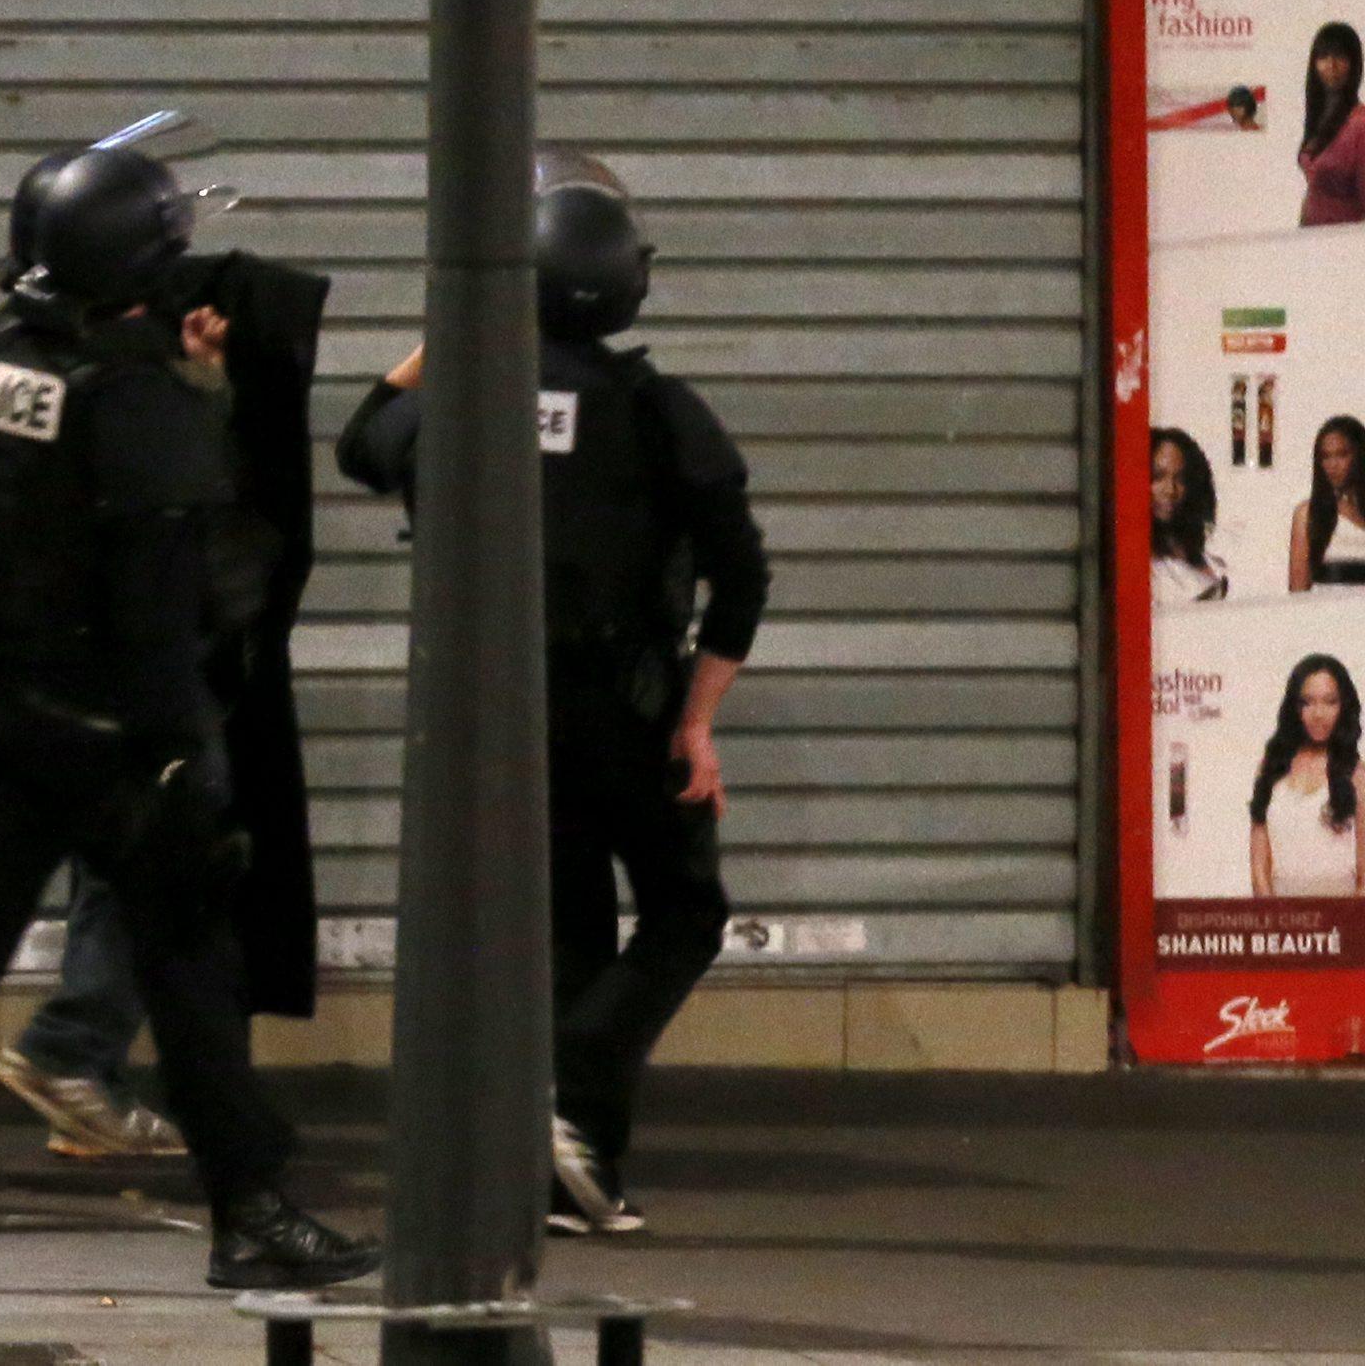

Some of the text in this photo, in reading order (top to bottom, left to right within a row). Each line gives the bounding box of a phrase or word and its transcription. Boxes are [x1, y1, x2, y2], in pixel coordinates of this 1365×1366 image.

[1157, 10, 1253, 37] fashion
[1178, 911, 1321, 929] DISPONIBLE CHEZ
[1157, 926, 1341, 956] SHAHIN BEAUTÉ
